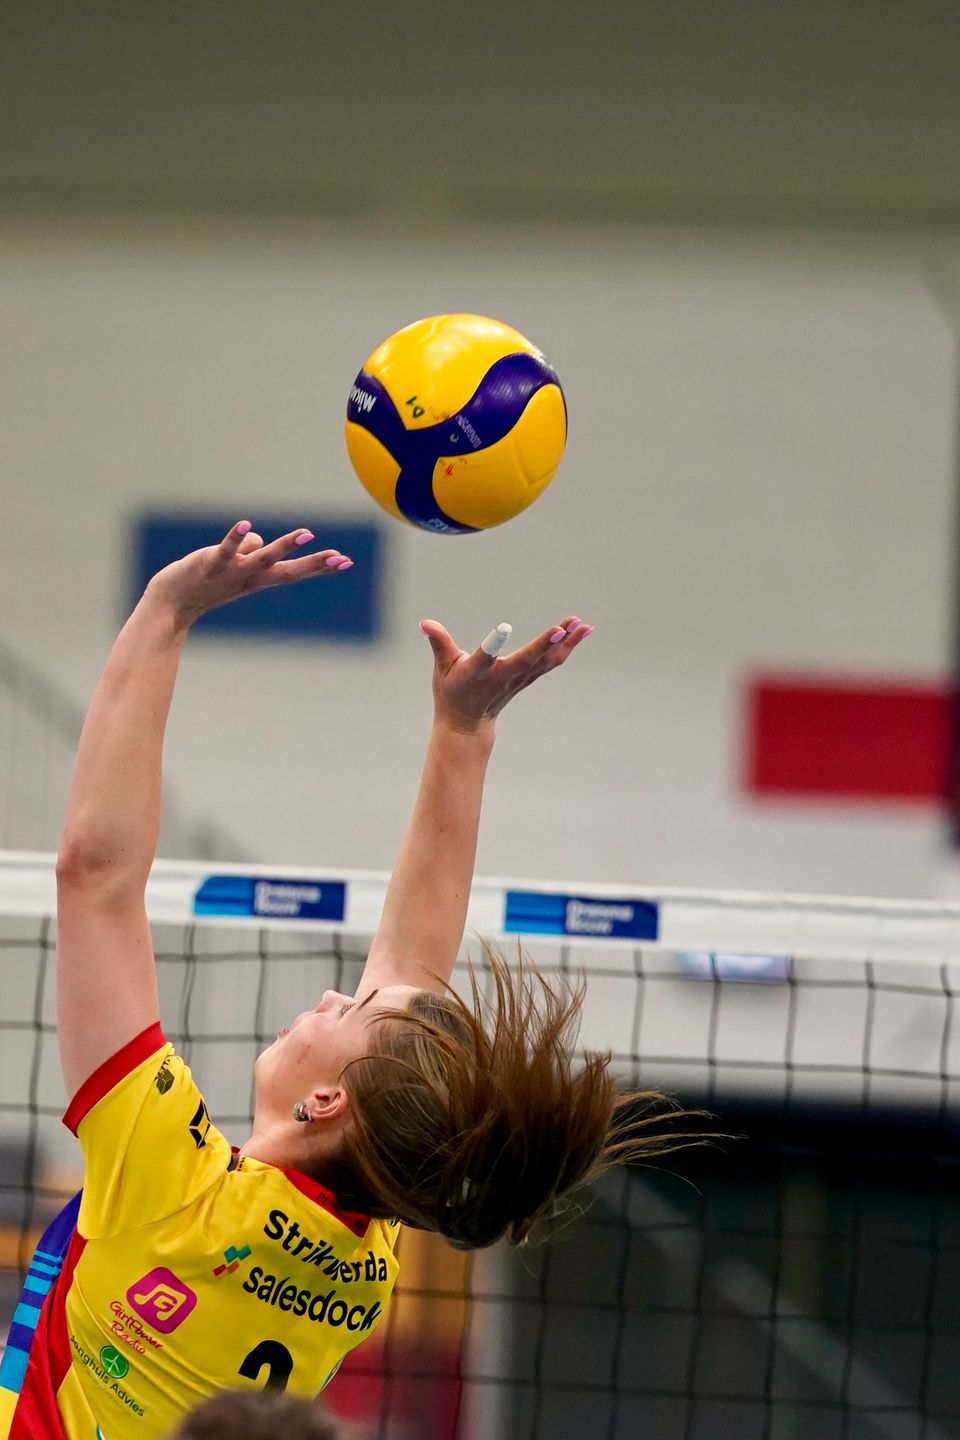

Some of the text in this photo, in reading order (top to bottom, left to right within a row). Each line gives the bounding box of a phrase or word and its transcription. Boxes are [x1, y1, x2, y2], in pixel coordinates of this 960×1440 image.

[242, 1266, 381, 1332] salesdock
[111, 1320, 146, 1354] Radio
[110, 1383, 144, 1417] Advies
